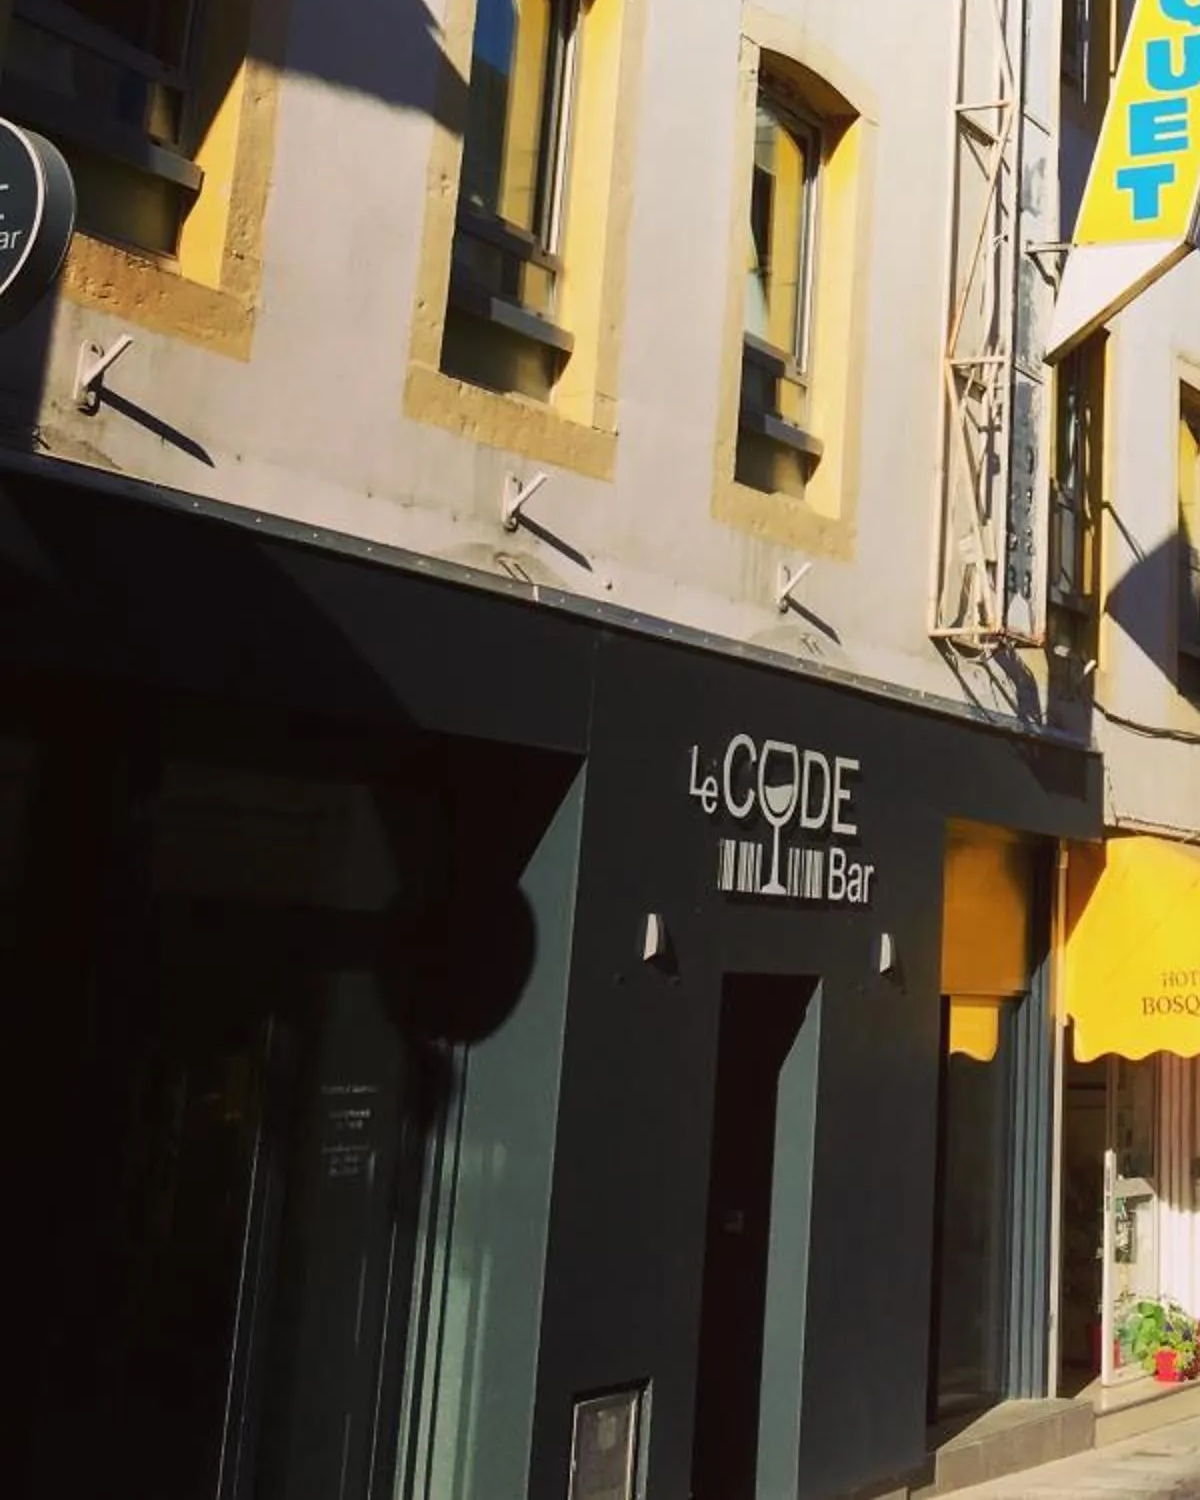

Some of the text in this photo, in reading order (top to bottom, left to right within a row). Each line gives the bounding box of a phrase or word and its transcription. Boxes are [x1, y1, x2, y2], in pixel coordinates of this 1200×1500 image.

[689, 733, 860, 835] Le CODE
[827, 847, 875, 903] Bar
